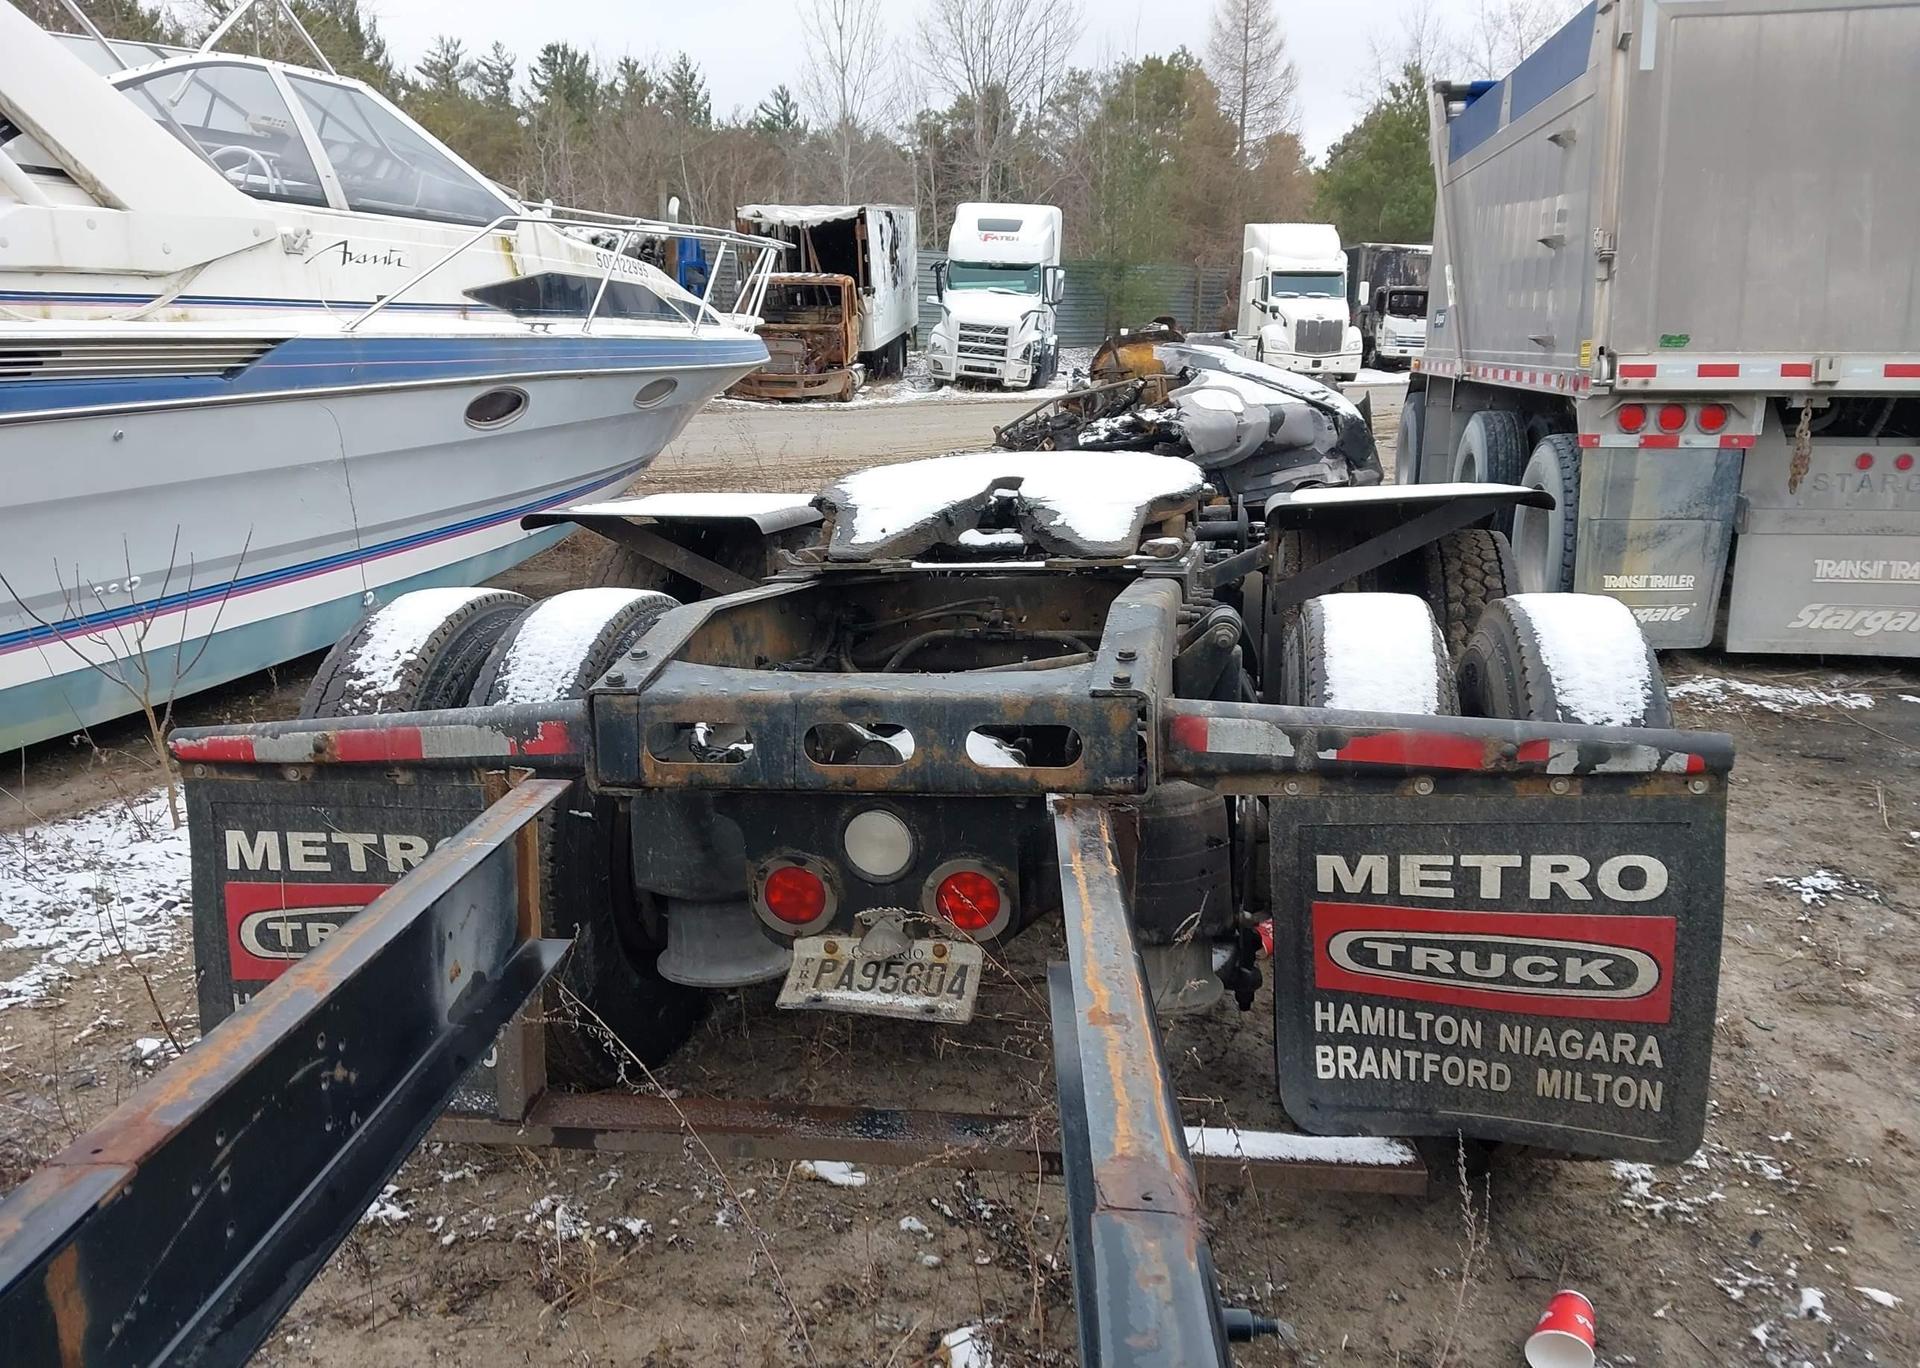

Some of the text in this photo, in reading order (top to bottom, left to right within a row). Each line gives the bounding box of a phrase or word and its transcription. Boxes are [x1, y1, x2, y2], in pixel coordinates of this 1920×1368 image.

[1603, 574, 1695, 588] TRANSIT TRAILER
[1814, 559, 1888, 579] TRANSIT
[225, 830, 451, 872] METR
[1316, 854, 1669, 902] METRO
[1363, 940, 1615, 986] TRUCK
[1314, 1000, 1664, 1069] HAMILTON NIAGARA
[1315, 1045, 1664, 1113] BRANTFORD MILTON
